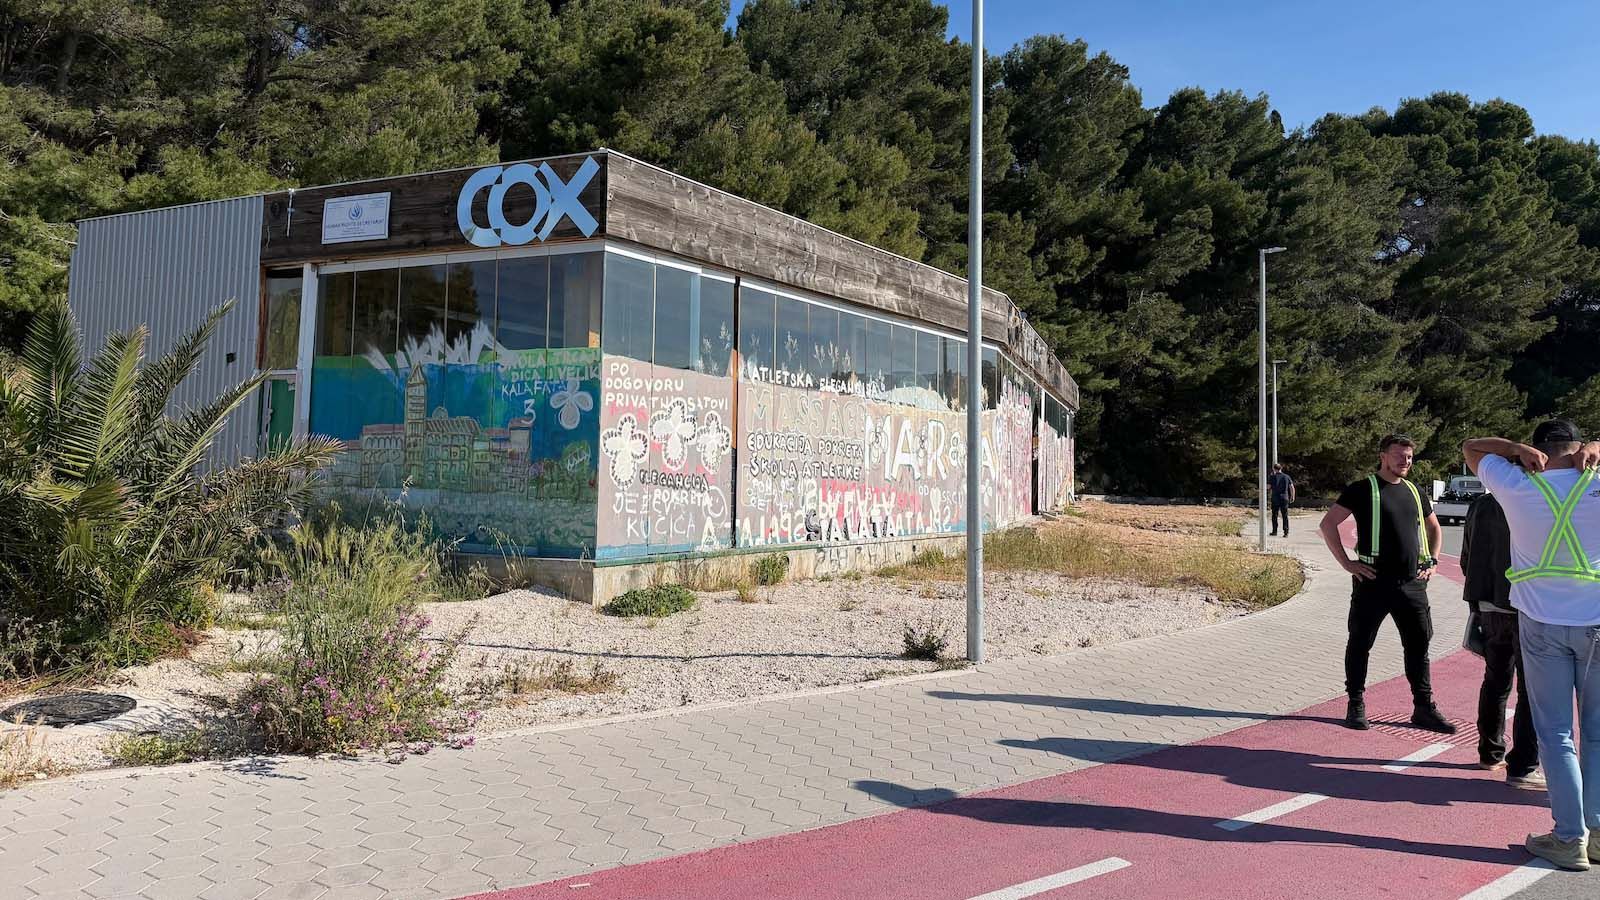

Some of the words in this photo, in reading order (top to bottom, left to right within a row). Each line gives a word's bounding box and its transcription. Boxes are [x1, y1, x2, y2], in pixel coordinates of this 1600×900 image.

[457, 155, 600, 247] COX
[609, 362, 630, 377] PO
[750, 365, 814, 388] ATLETSKA
[605, 378, 684, 393] DOGOVORU
[687, 396, 729, 412] SATOVI
[750, 453, 798, 479] ŠKOLA
[801, 461, 862, 480] ATLETIKE
